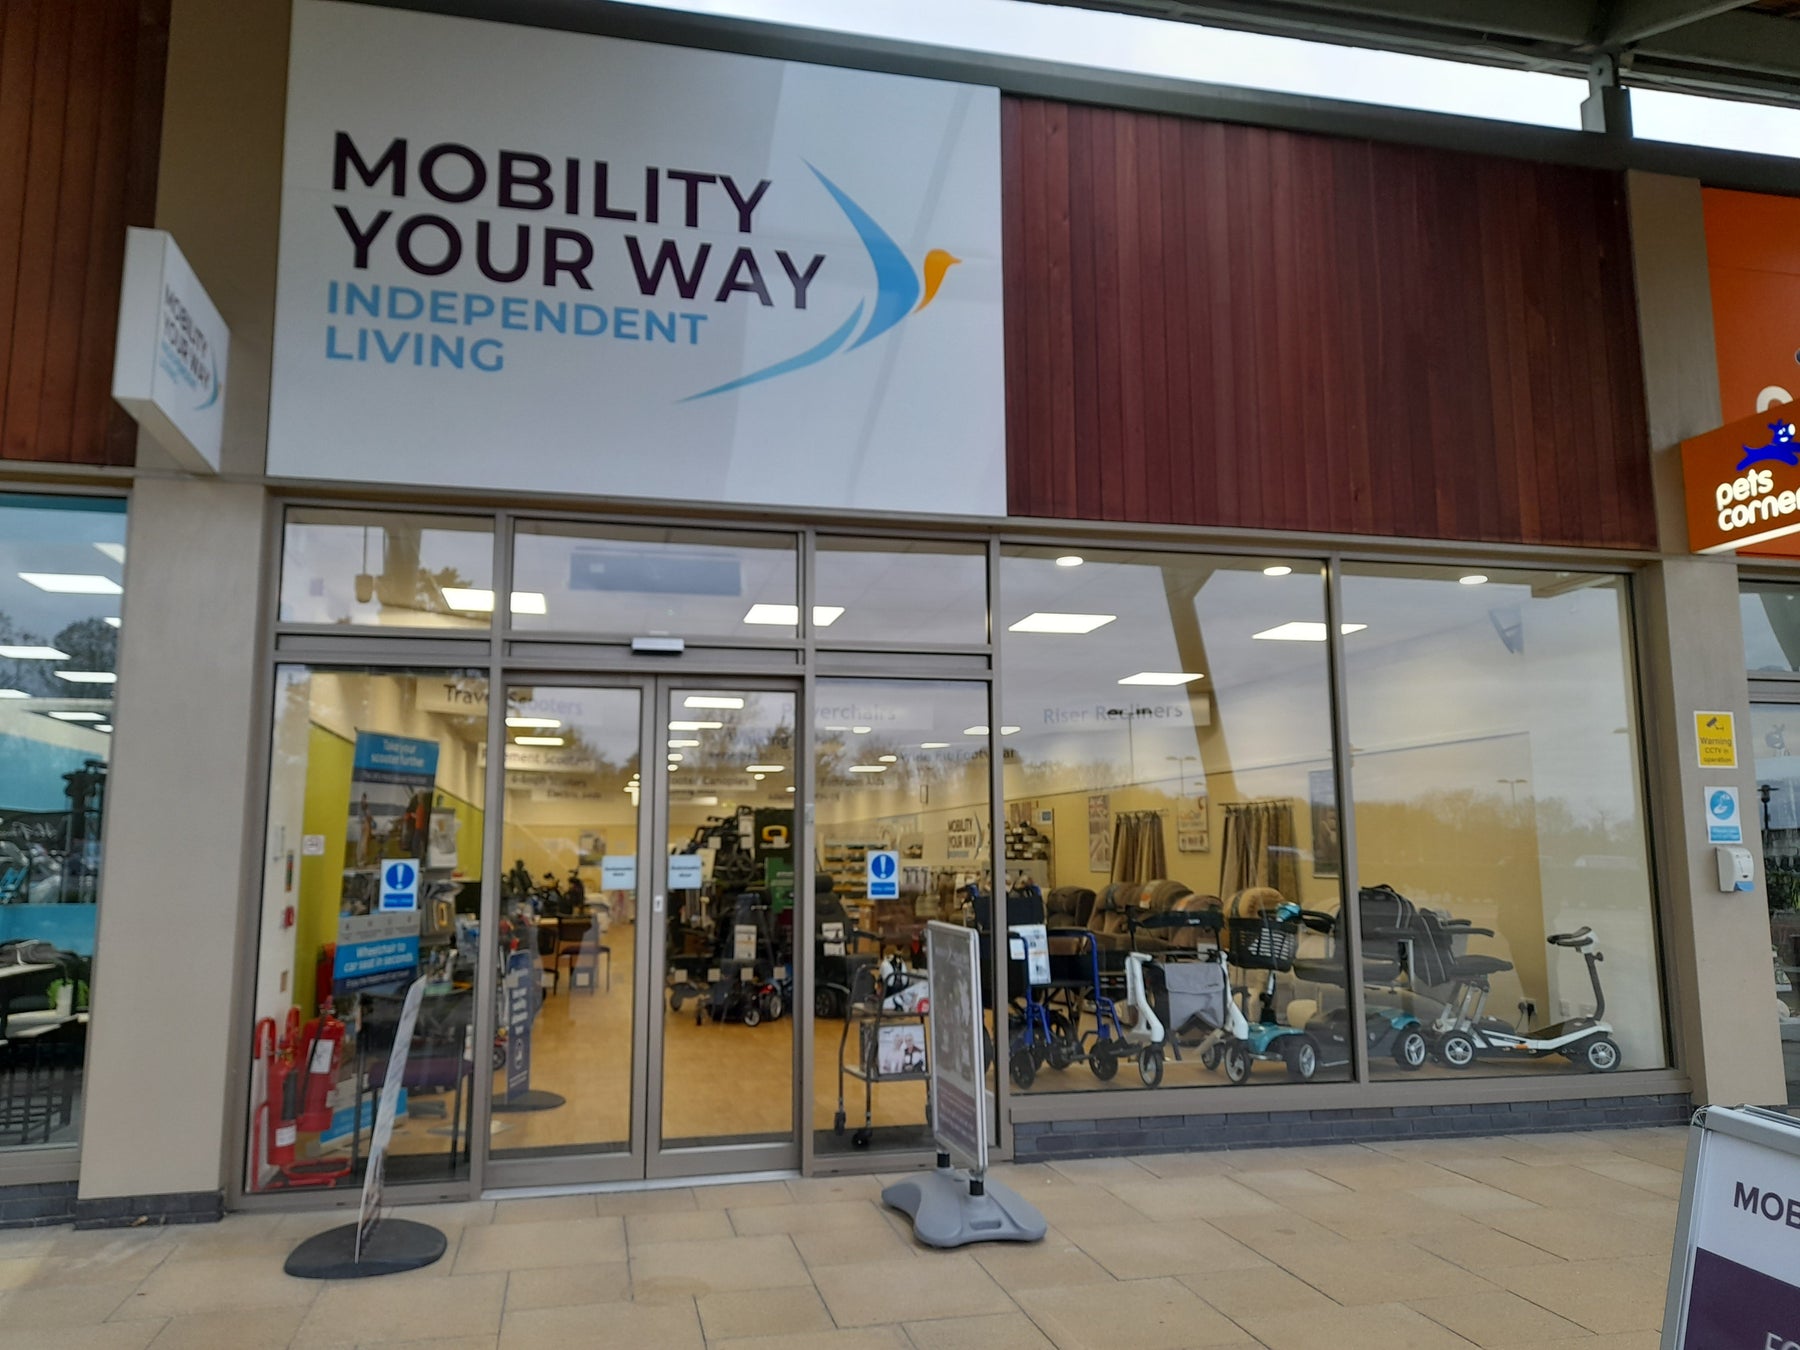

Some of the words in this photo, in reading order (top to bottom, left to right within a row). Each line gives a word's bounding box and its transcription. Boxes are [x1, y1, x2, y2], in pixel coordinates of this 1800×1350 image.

[332, 131, 772, 234] MOBILITY
[333, 205, 594, 291] YOUR
[625, 235, 827, 310] WAY
[326, 280, 708, 345] INDEPENDENT
[325, 327, 505, 373] LIVING
[1716, 468, 1774, 511] pets
[1718, 488, 1800, 531] corne
[443, 684, 490, 705] Trav
[1043, 708, 1087, 724] Riser
[1095, 704, 1183, 721] Recliners
[1700, 736, 1733, 748] Warning
[1733, 1181, 1800, 1231] MOB
